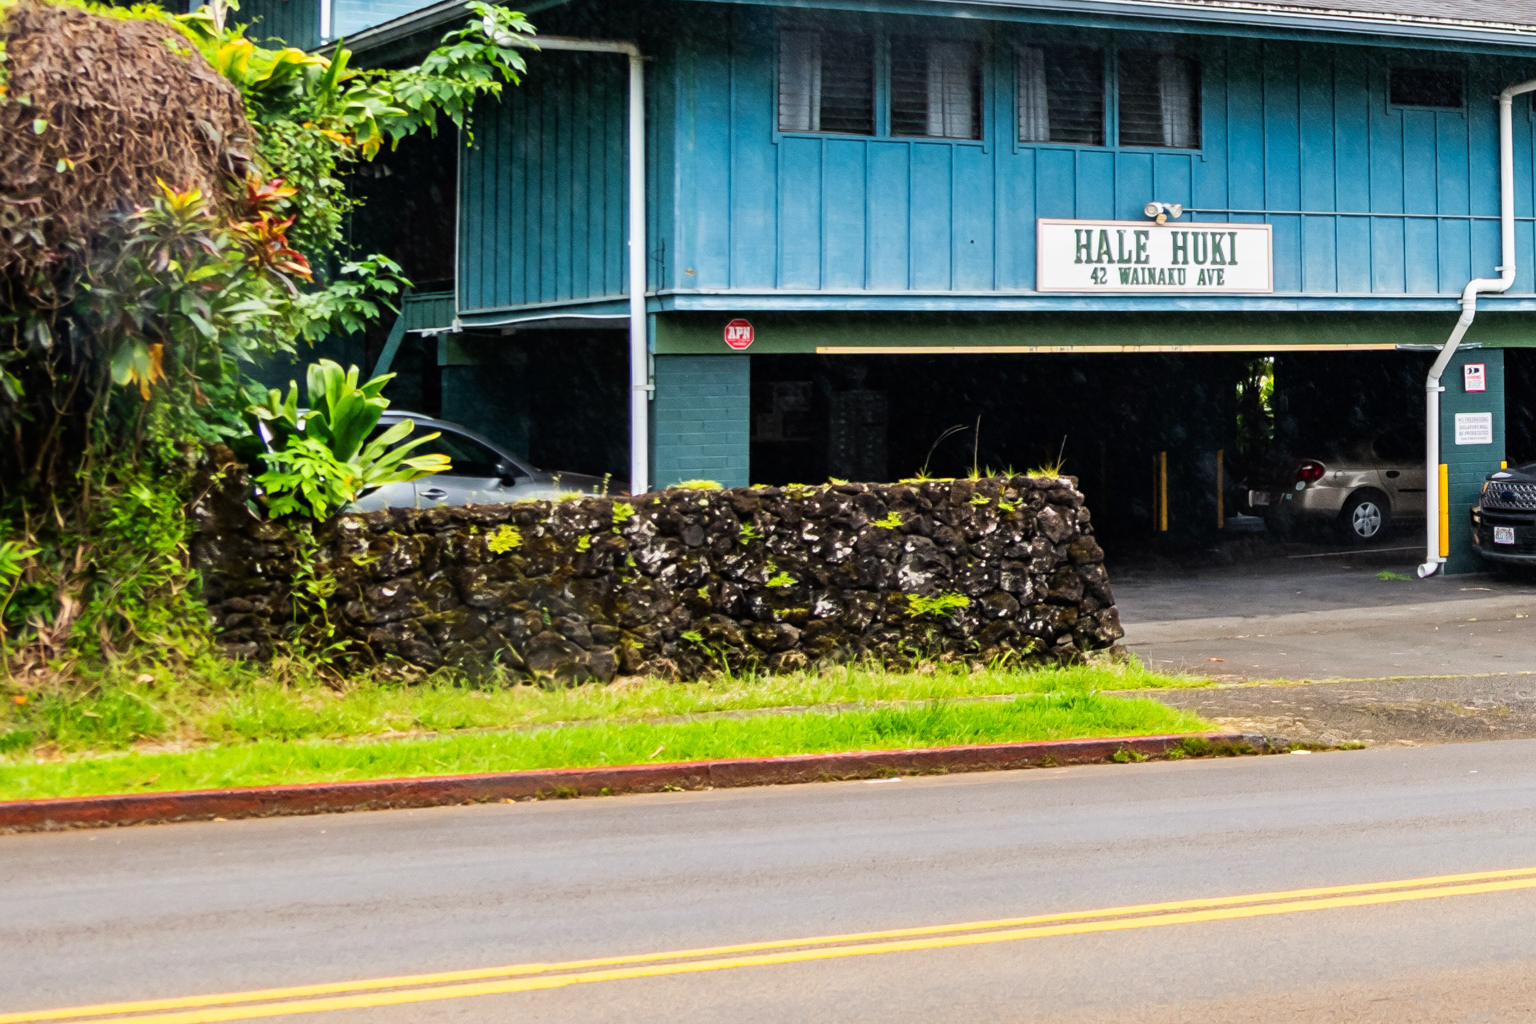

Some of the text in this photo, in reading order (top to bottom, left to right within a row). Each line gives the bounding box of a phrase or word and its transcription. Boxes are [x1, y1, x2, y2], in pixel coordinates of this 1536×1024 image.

[1074, 228, 1238, 265] HALE HUKI
[1090, 266, 1225, 286] 42 WAINAKU AVE
[727, 326, 751, 340] APN
